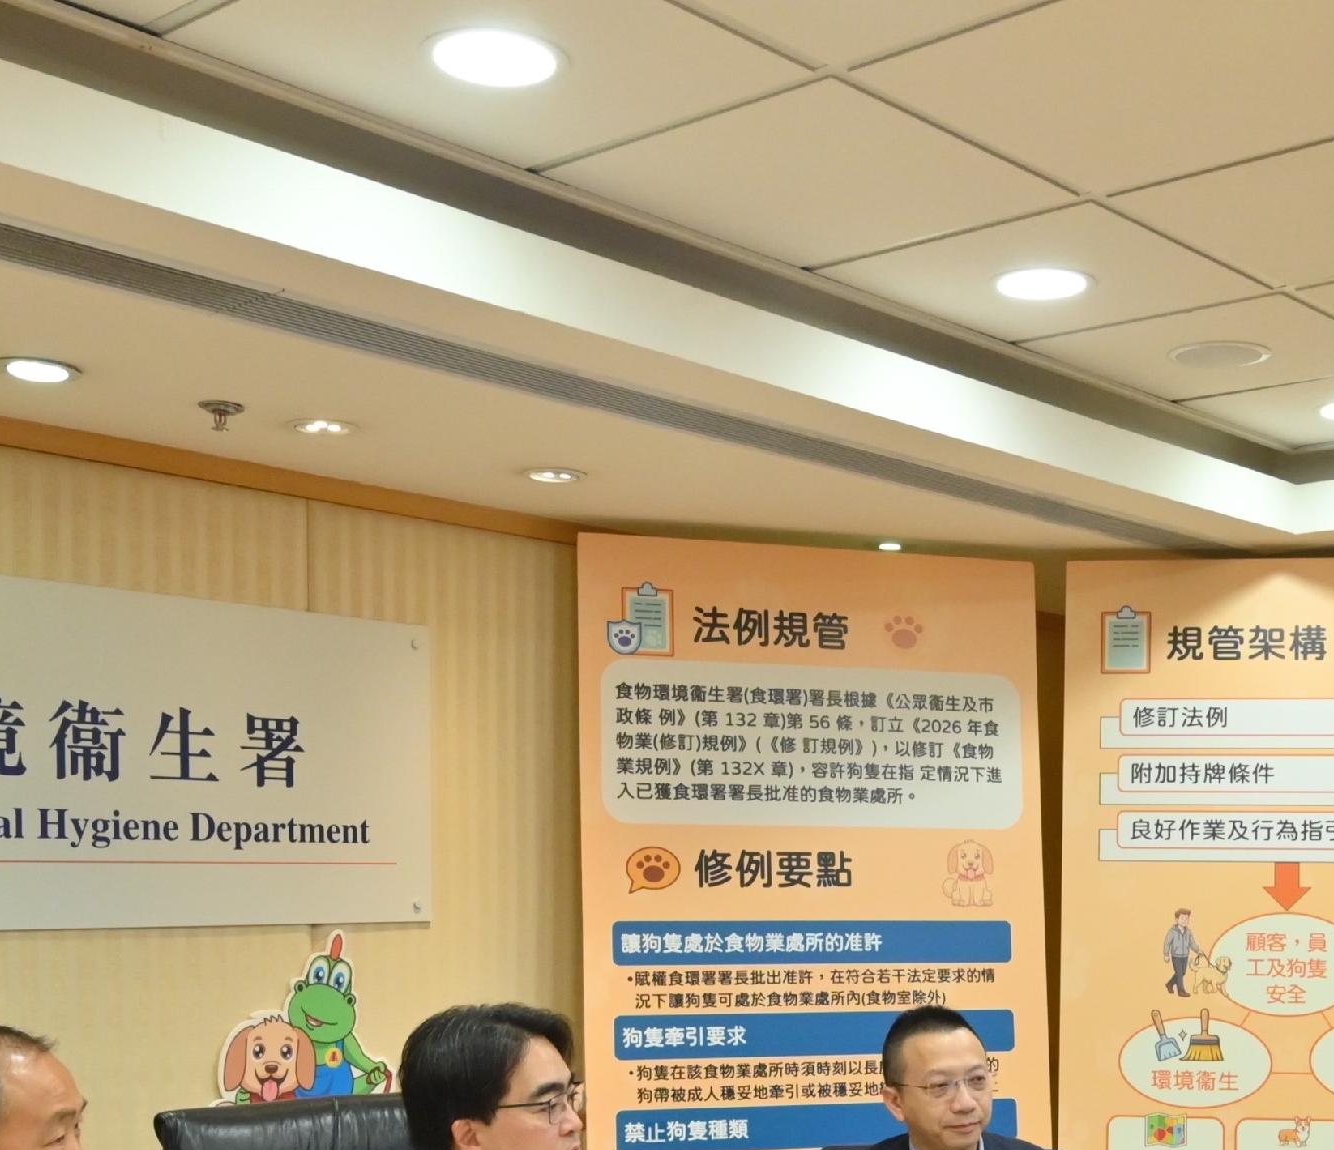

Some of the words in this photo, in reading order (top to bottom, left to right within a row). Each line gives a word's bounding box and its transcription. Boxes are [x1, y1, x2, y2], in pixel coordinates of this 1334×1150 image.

[693, 606, 849, 649] 法例規管
[1167, 624, 1328, 661] 規管架構
[725, 712, 757, 727] 132
[810, 715, 830, 730] 56
[1133, 706, 1228, 728] 修訂法例
[721, 761, 765, 777] 132X
[1131, 762, 1274, 785] 附加持牌條件
[38, 806, 179, 849] Hygiene
[190, 811, 370, 851] Department
[695, 849, 852, 888] 修例要點
[621, 932, 883, 954] 讓狗隻處於食物業處所的准許
[1246, 931, 1328, 954] 顧客，員
[1246, 957, 1328, 980] 工及狗隻
[1266, 983, 1307, 1005] 安全
[622, 1026, 747, 1049] 狗隻牽引要求
[636, 1060, 883, 1082] 狗隻在該食物業處所時須時刻以長
[624, 1119, 749, 1143] 禁止狗隻種類
